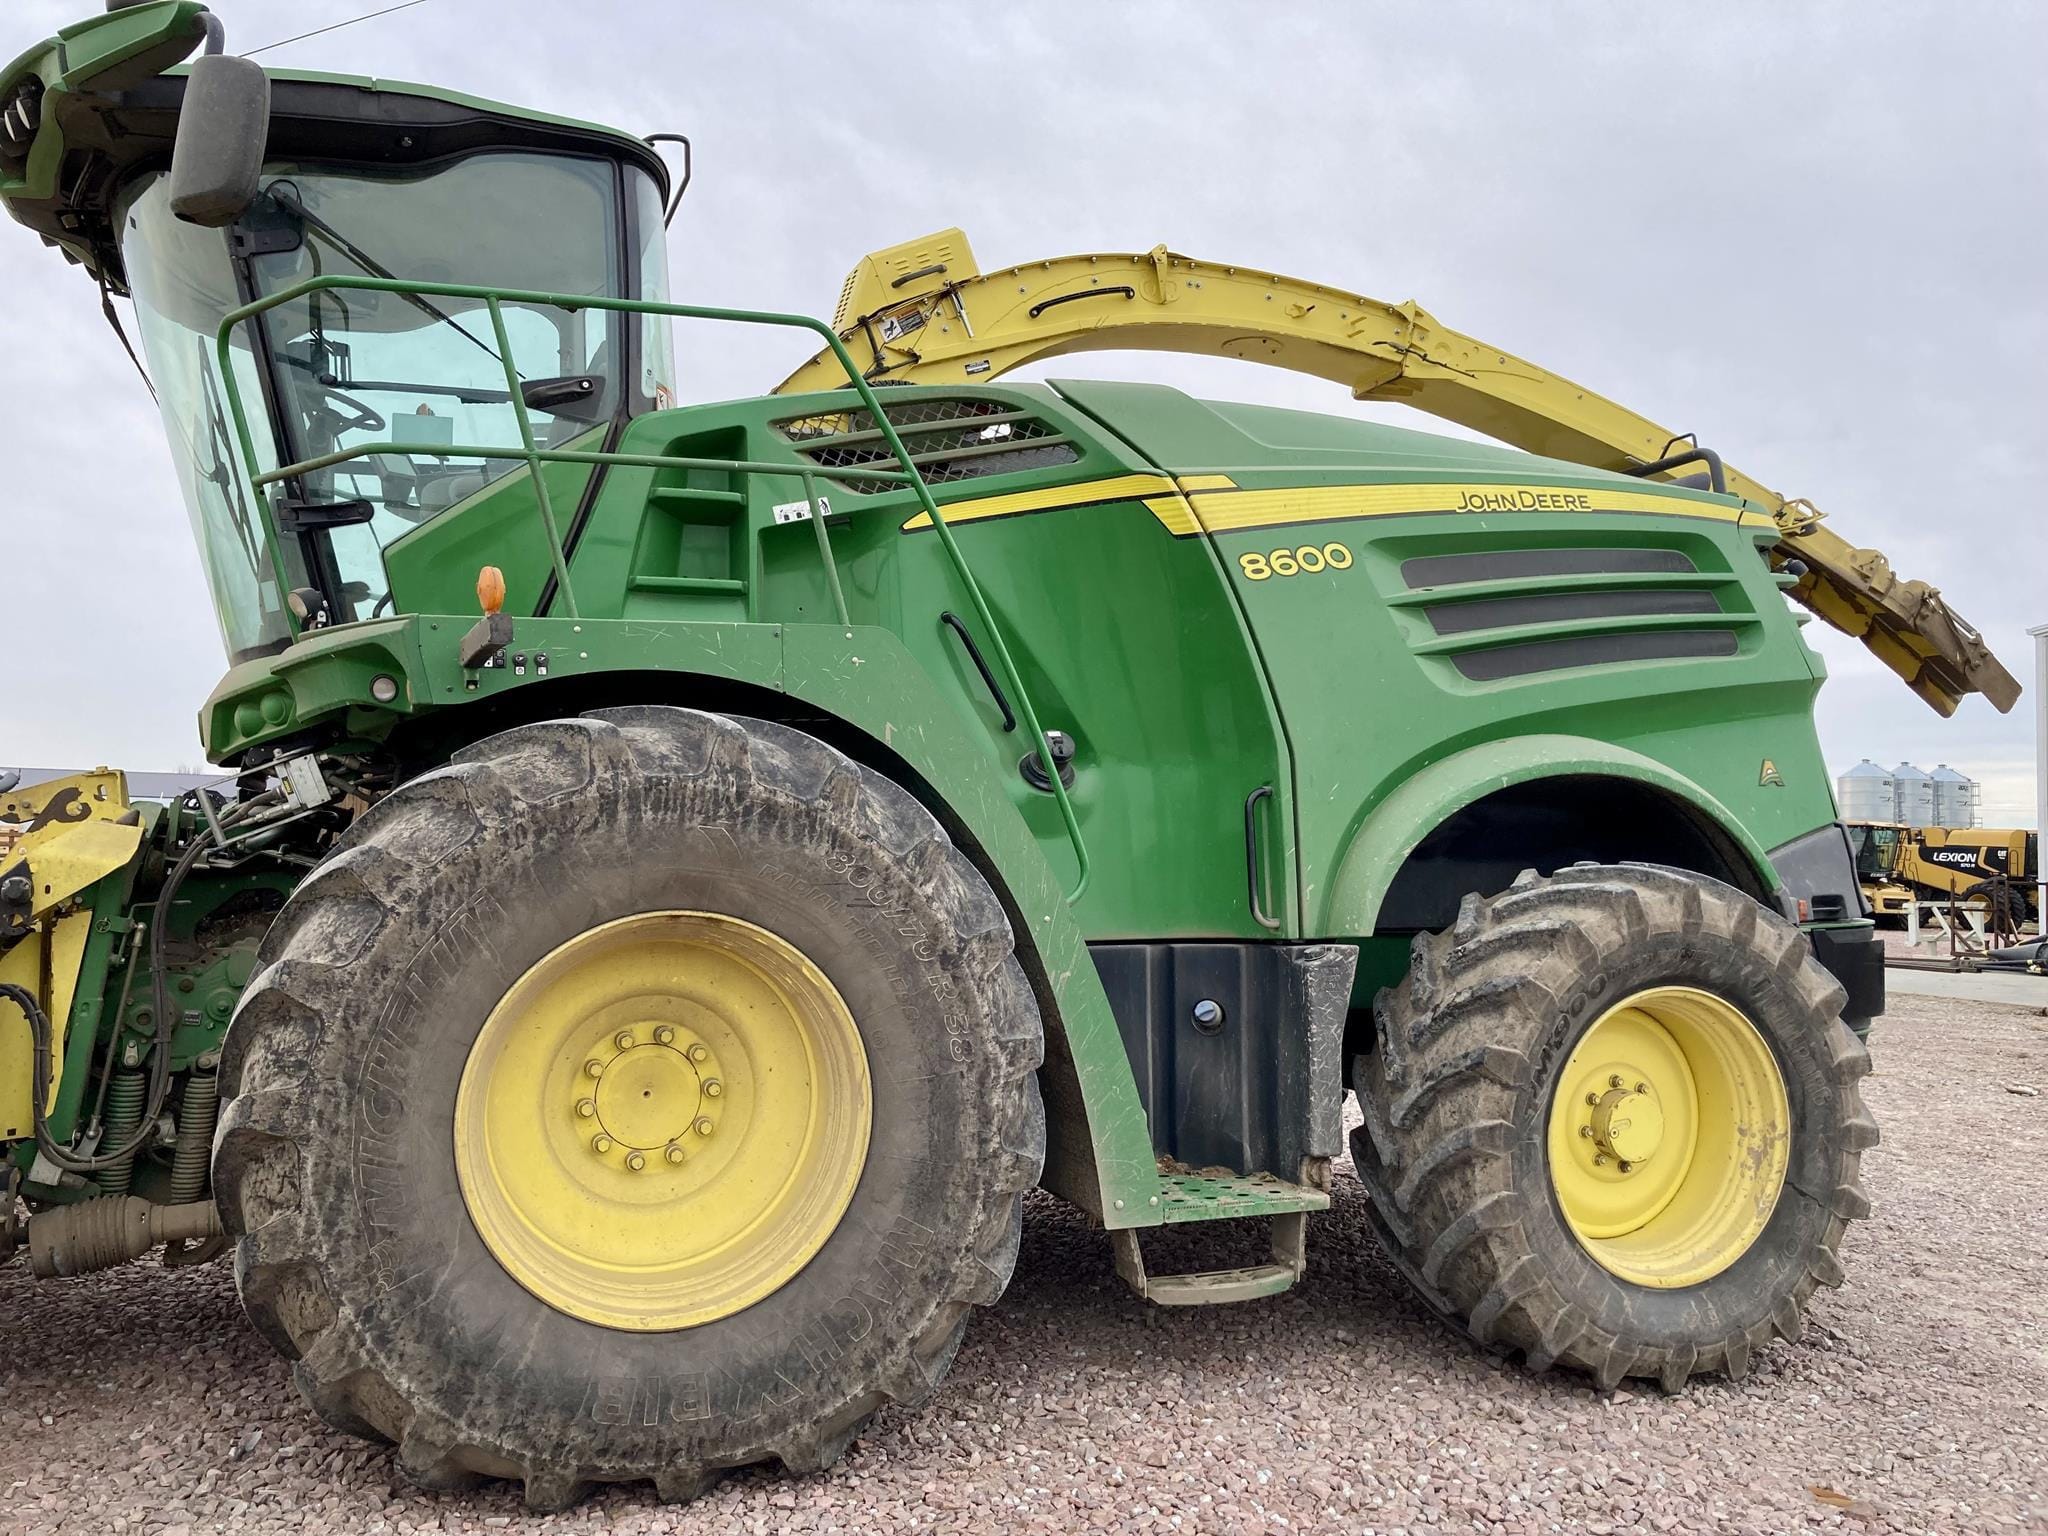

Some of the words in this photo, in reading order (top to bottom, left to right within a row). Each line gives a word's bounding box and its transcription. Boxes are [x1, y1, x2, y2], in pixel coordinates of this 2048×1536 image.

[1457, 491, 1517, 510] JOHN
[1518, 491, 1592, 510] DEERE
[1238, 541, 1354, 581] 8600
[1933, 852, 1977, 863] LEXION
[825, 852, 938, 962] 800/70
[928, 974, 960, 1002] R
[944, 1014, 975, 1063] 38
